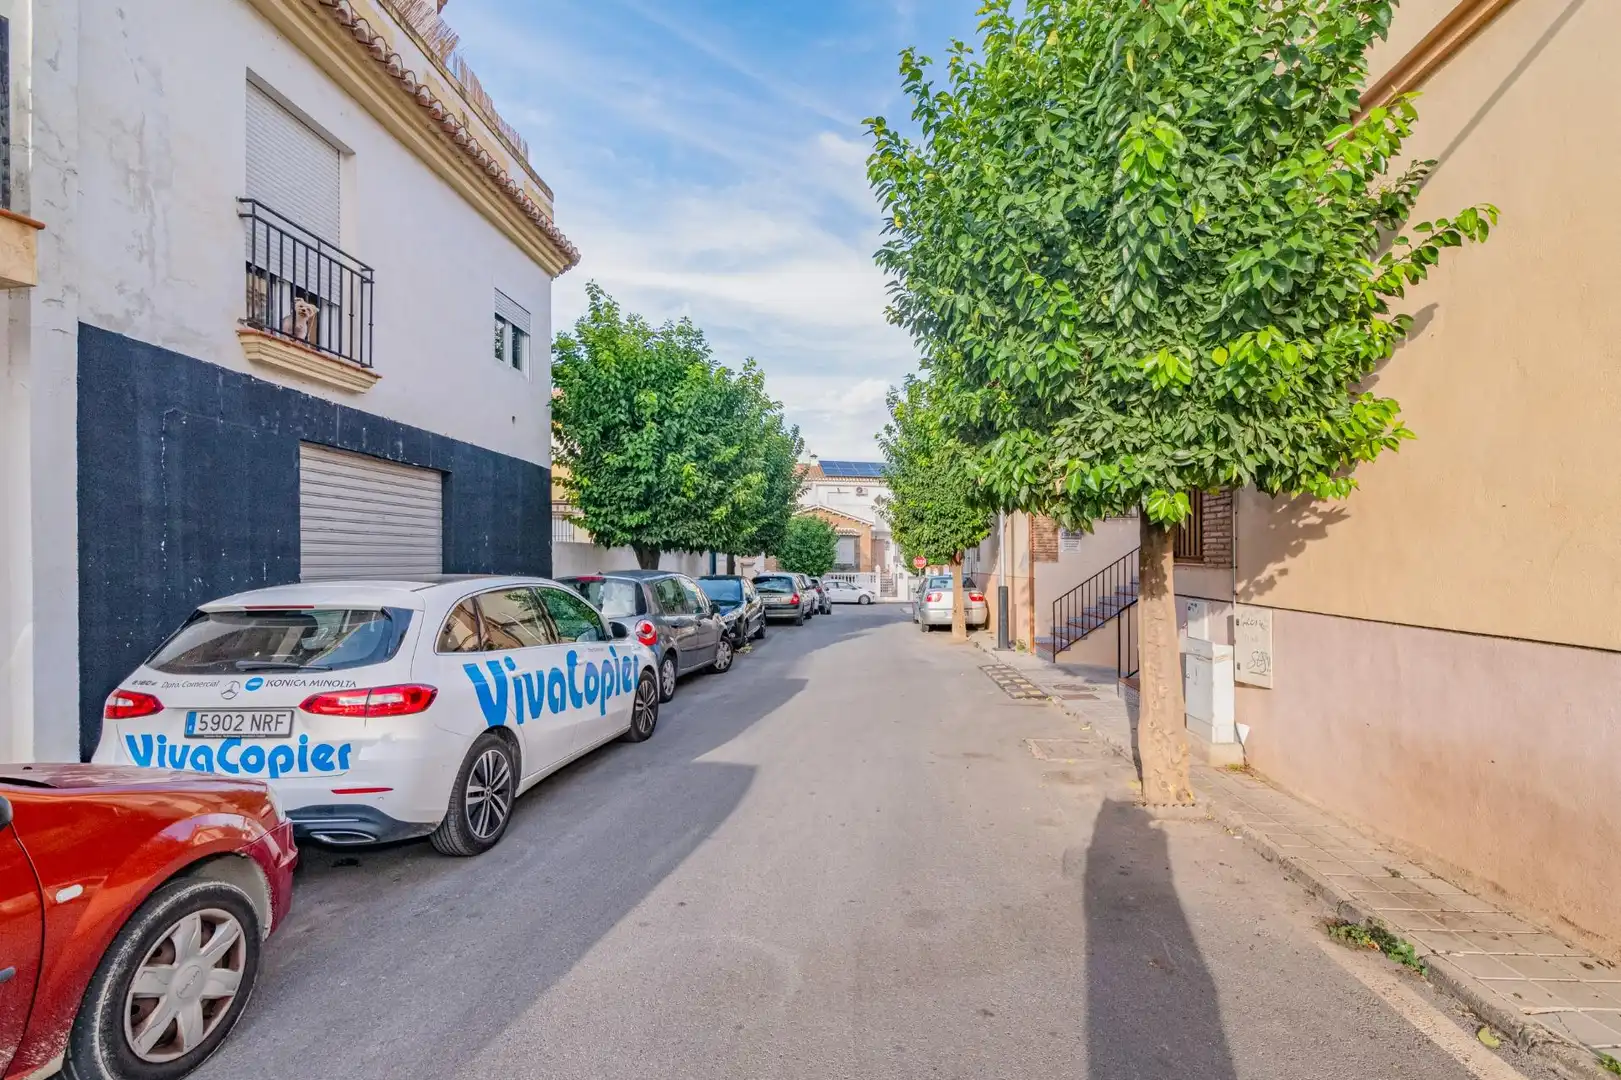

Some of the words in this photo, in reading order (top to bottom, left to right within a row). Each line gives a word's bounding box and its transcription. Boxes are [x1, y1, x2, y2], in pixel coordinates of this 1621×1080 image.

[181, 680, 220, 688] Comercial
[265, 679, 306, 688] KONICA
[309, 679, 357, 688] MINOLTA
[463, 645, 639, 727] VivaCopier
[198, 714, 243, 732] 5902
[250, 713, 287, 732] NRF
[125, 733, 351, 779] VivaCopier
